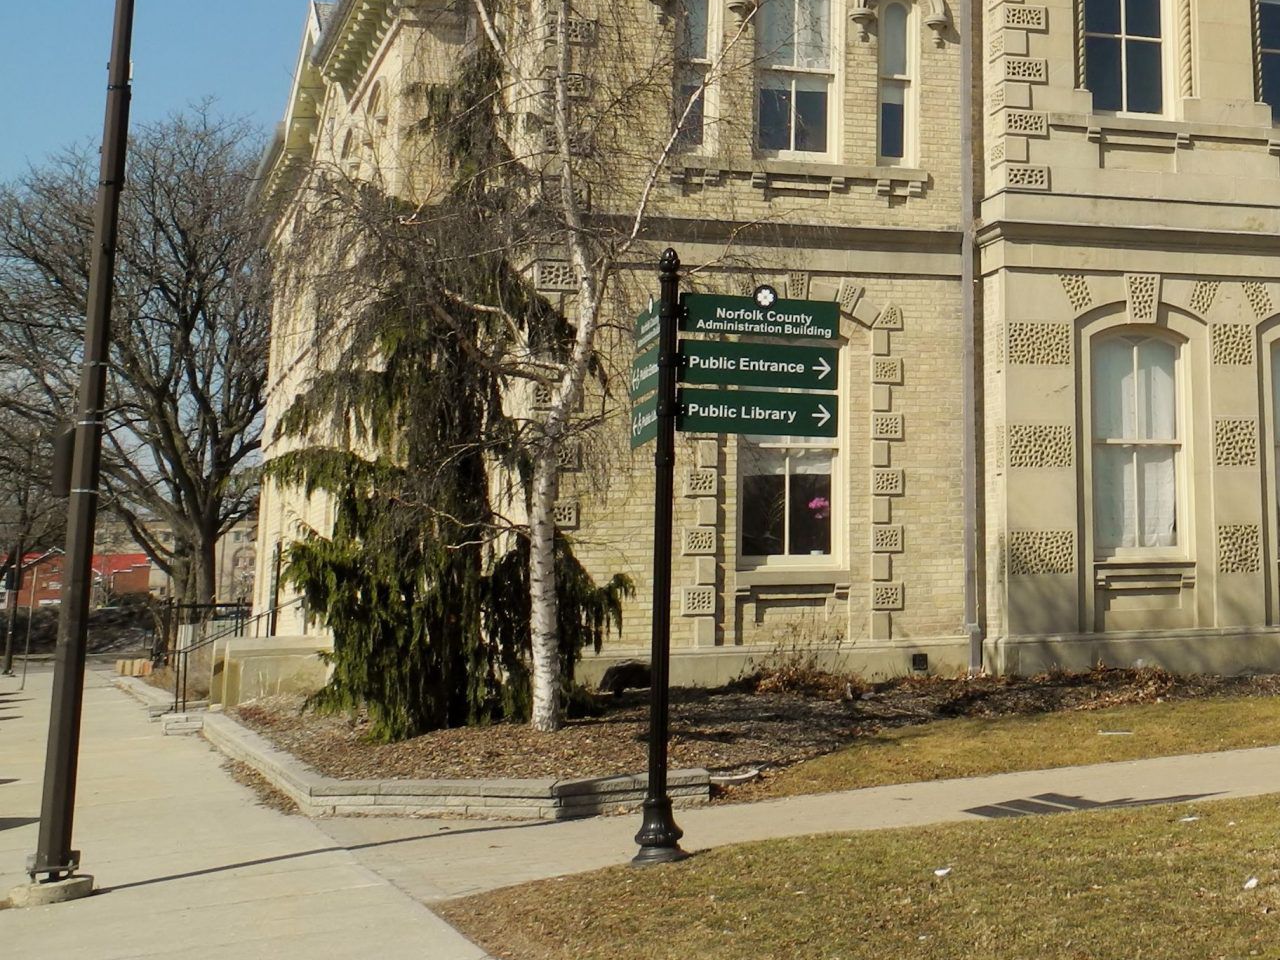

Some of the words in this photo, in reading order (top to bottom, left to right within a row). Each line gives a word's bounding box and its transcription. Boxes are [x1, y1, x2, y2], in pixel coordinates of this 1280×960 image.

[716, 307, 764, 321] Norfolk
[767, 311, 813, 326] County
[696, 319, 782, 334] Administration
[784, 324, 832, 339] Building
[689, 355, 736, 370] Public
[739, 357, 805, 373] Entrance
[688, 403, 737, 418] Public
[741, 406, 797, 423] Library
